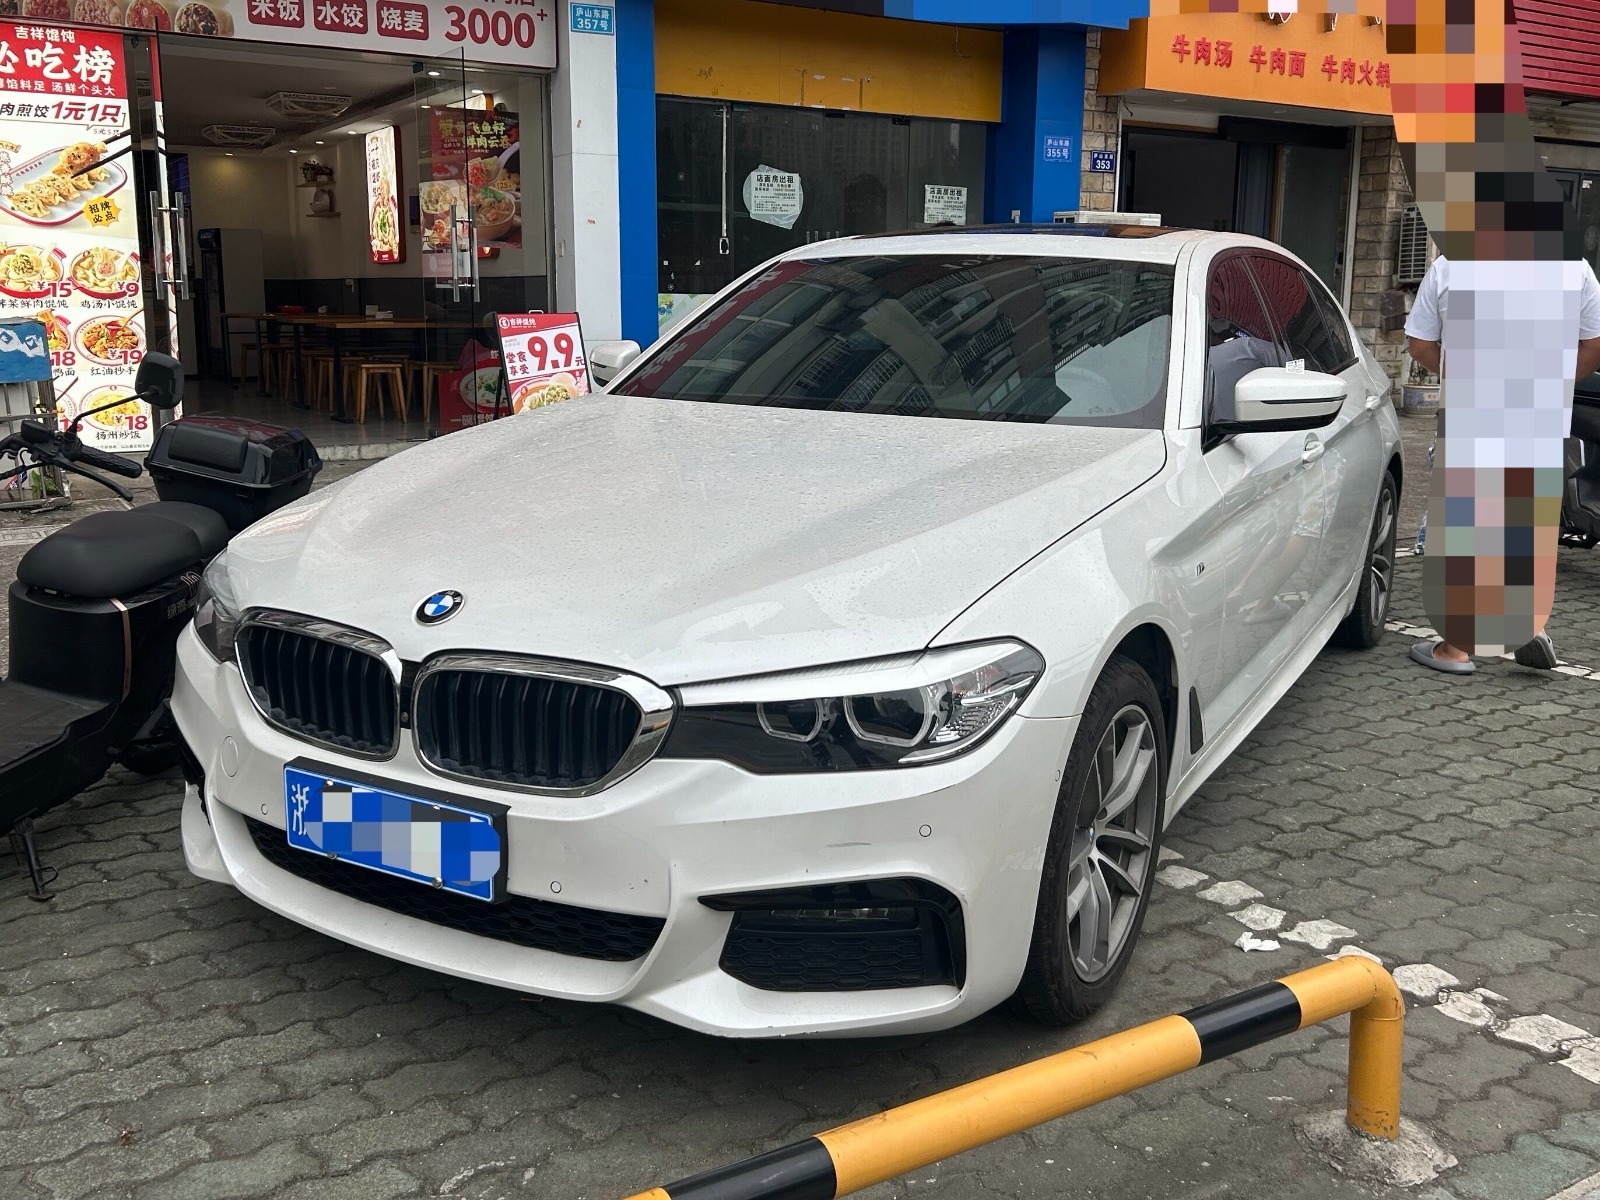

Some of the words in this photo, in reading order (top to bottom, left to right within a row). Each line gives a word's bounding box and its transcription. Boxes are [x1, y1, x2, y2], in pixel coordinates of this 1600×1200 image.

[251, 0, 300, 21] 米饭
[317, 1, 364, 28] 水饺
[380, 6, 425, 33] 烧麦
[576, 7, 610, 19] 庐山东路
[577, 18, 608, 31] 357号
[15, 26, 76, 43] 吉祥馄饨
[1171, 34, 1233, 68] 牛肉汤
[1249, 45, 1307, 78] 牛肉面
[1321, 55, 1390, 88] 牛肉火锅
[52, 82, 116, 96] 汤鲜个头大
[0, 103, 50, 119] 肉煎饺
[51, 101, 122, 123] 1元1只
[1046, 148, 1069, 159] 355号
[1095, 159, 1111, 170] 353
[756, 174, 794, 184] 店面房出租
[89, 201, 112, 214] 招牌
[93, 211, 116, 224] 必点
[80, 300, 138, 309] 鸡汤小馄饨
[506, 351, 527, 364] 堂食
[527, 333, 574, 371] 9.9
[90, 367, 136, 376] 红油抄手
[509, 364, 530, 376] 享受
[96, 431, 141, 440] 扬州炒饭
